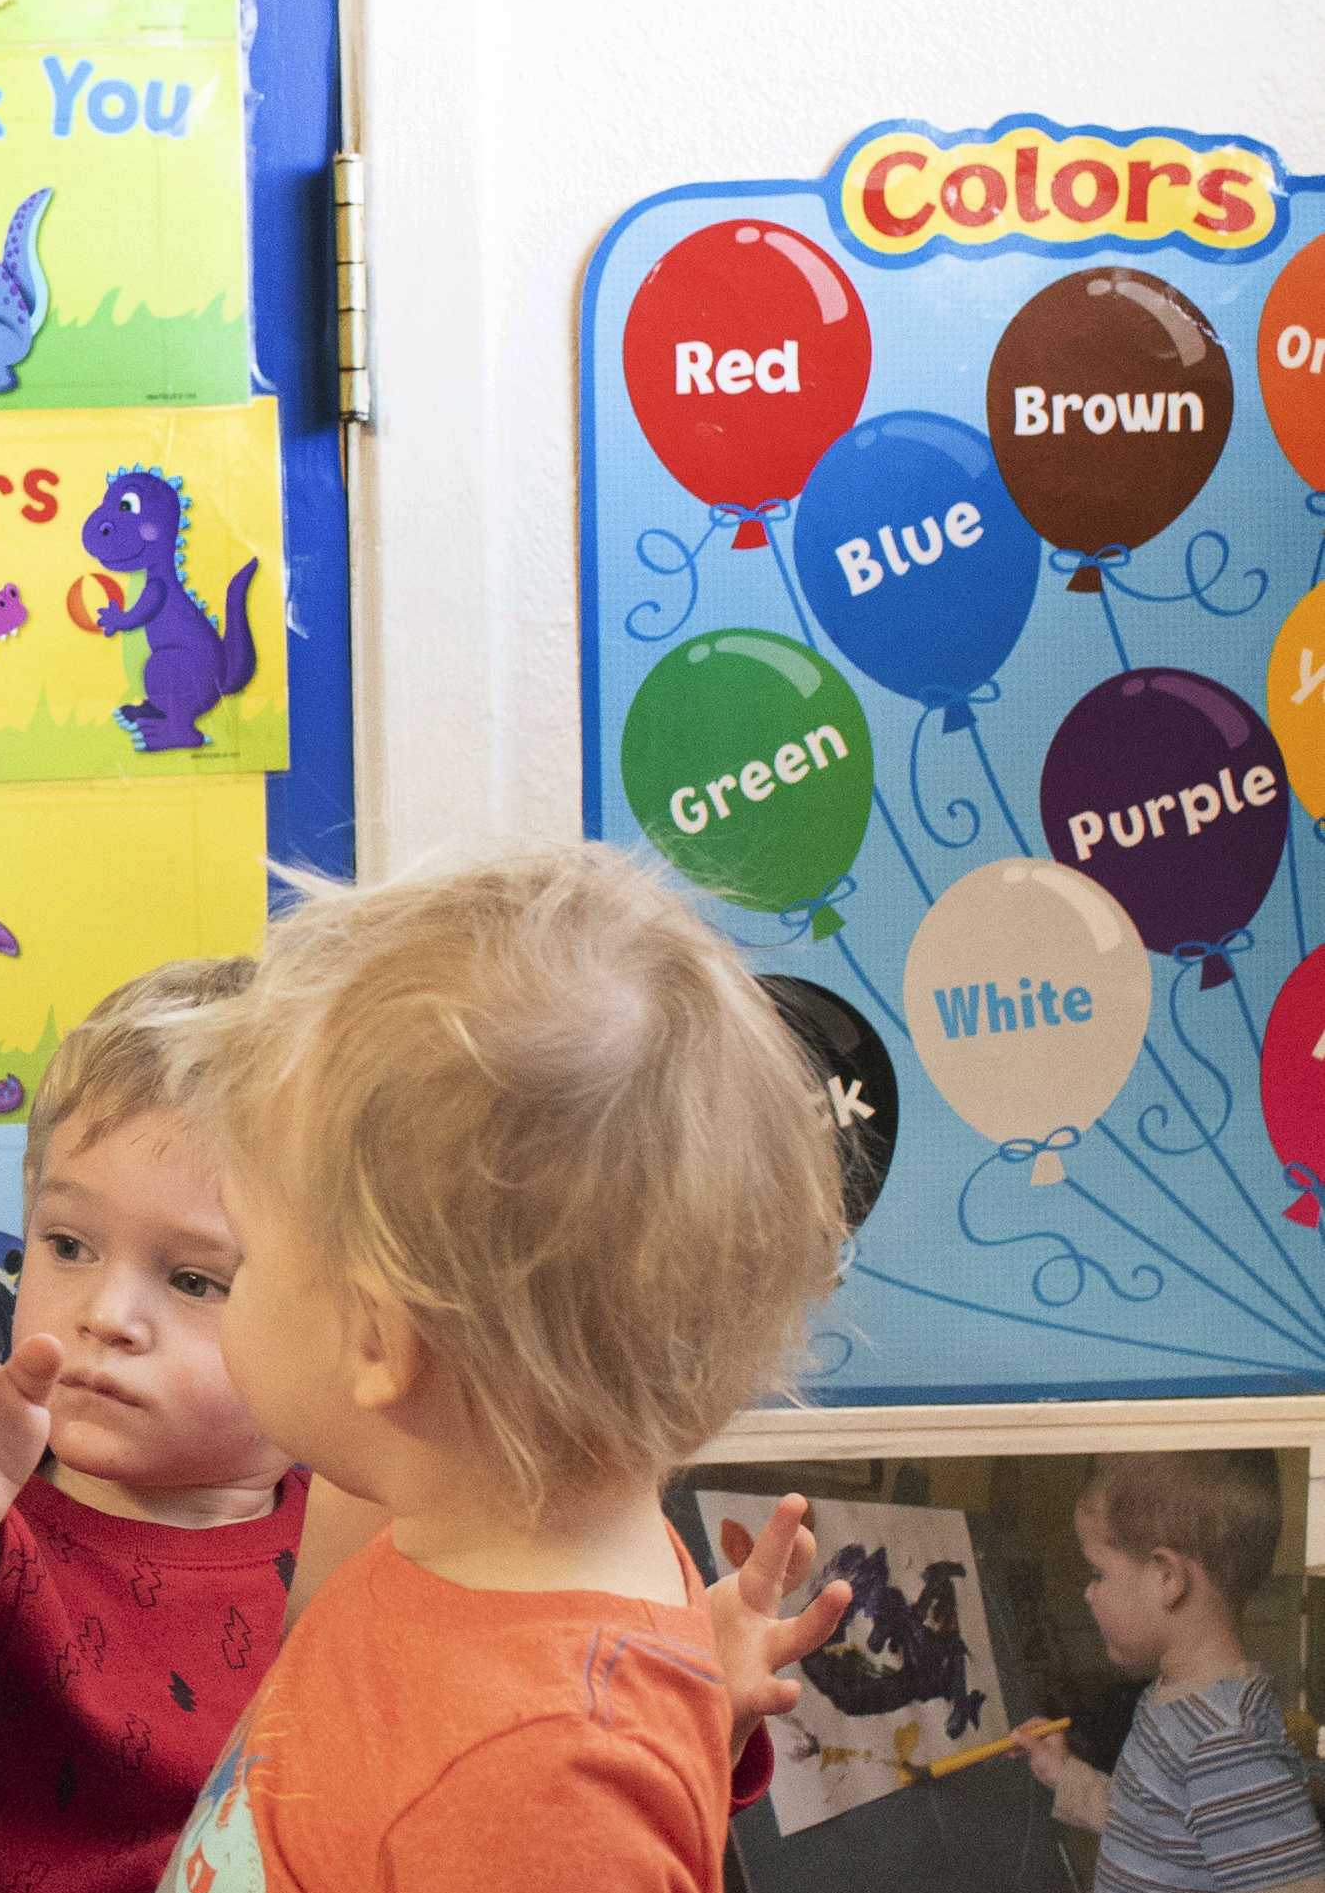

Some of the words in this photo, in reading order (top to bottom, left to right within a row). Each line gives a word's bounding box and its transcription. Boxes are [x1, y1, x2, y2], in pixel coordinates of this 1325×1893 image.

[44, 55, 191, 139] You
[862, 147, 1257, 238] Colors
[674, 340, 801, 394] Red
[1014, 386, 1204, 435] Brown
[835, 501, 985, 597] Blue
[669, 722, 849, 835] Green
[1068, 765, 1278, 860] Purple
[934, 977, 1094, 1040] White
